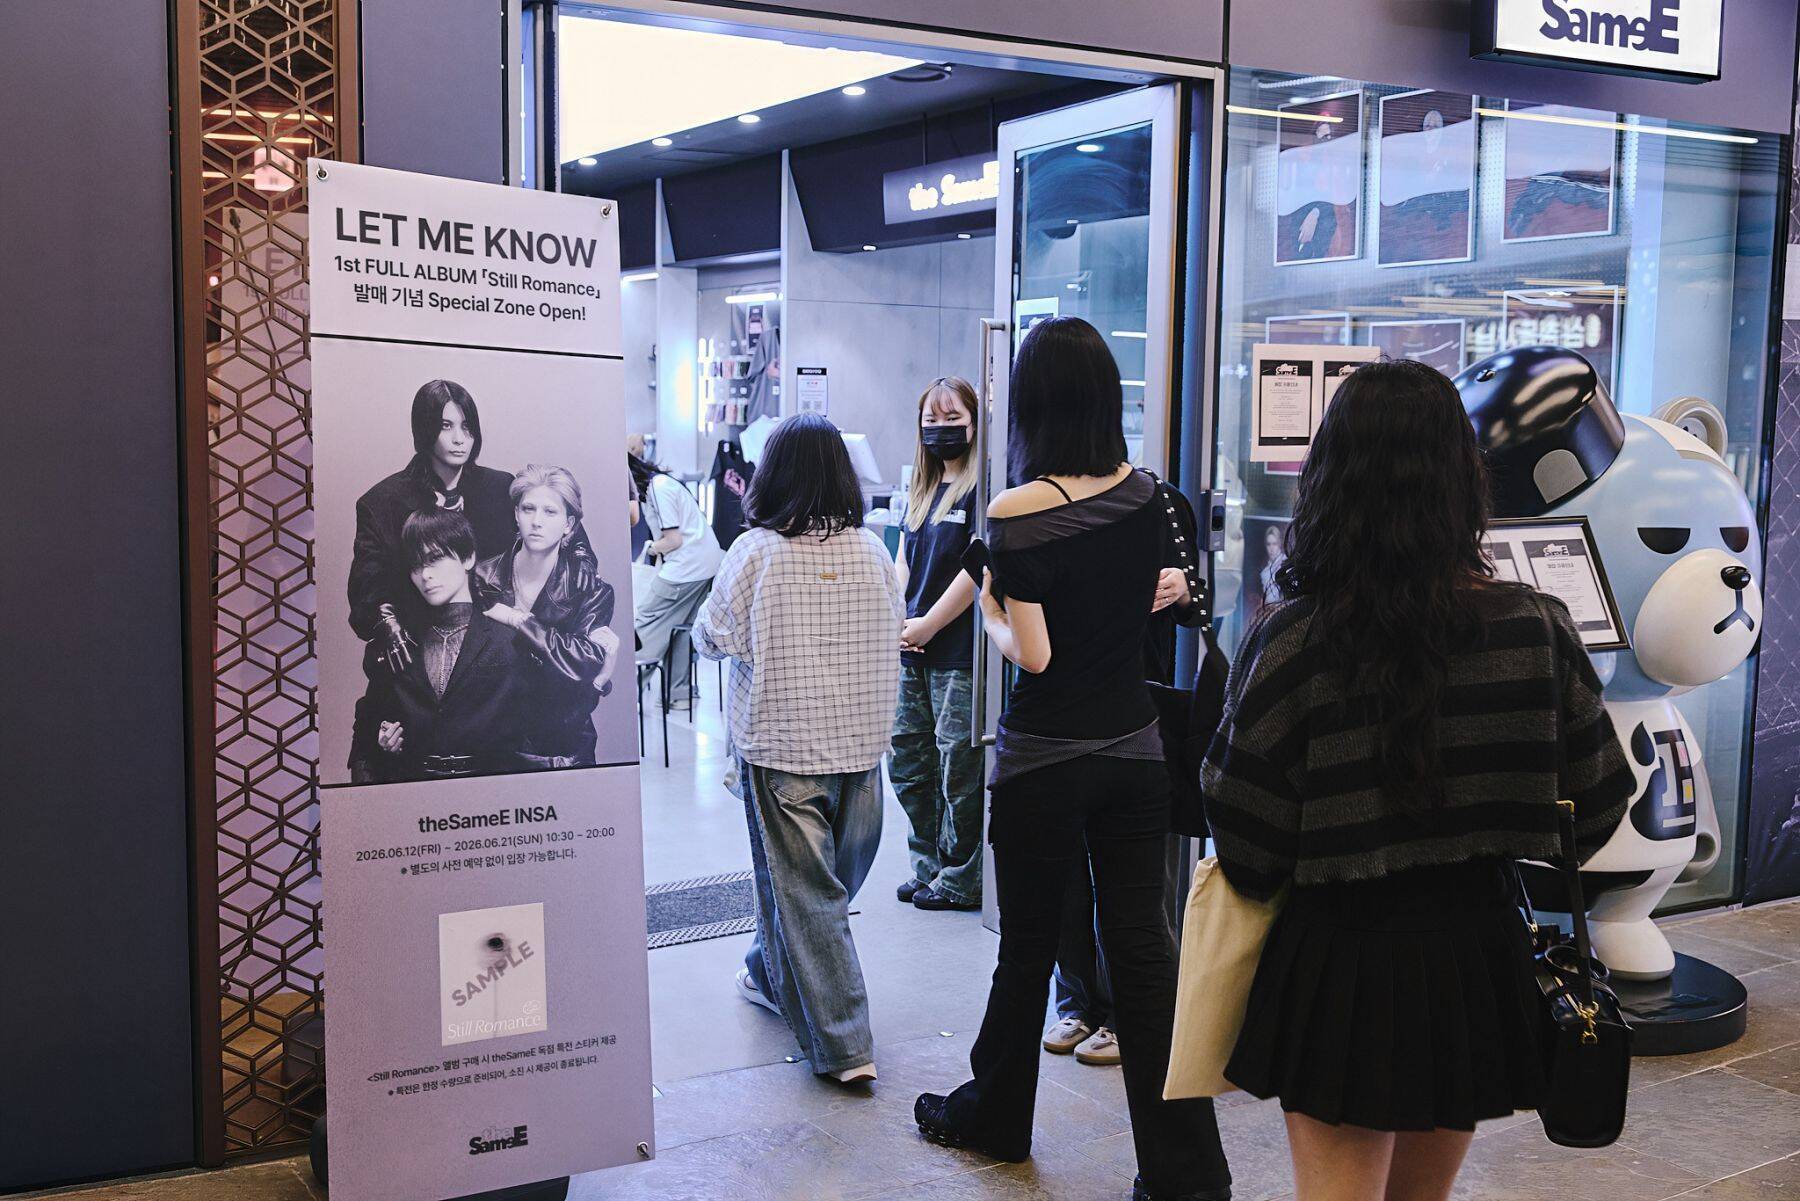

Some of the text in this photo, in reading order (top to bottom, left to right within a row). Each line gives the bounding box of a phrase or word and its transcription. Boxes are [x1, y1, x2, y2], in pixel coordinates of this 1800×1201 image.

[1539, 0, 1680, 54] SameE
[336, 207, 597, 268] LET ME KNOW
[334, 255, 360, 273] 1st
[365, 258, 409, 278] FULL
[414, 264, 477, 285] ALBUM
[354, 284, 586, 322] 발매 기념 Special Zone Open!
[418, 805, 558, 833] theSameE INSA
[356, 843, 441, 862] 2026.06.12(FRI)
[454, 834, 543, 852] 2026.06.21(SUN)
[546, 830, 574, 843] 10:30
[586, 826, 615, 840] 20:00
[410, 848, 577, 876] 별도의 사전 예약 없이 입장 가능합니다.
[451, 941, 535, 1007] SAMPLE
[447, 1014, 541, 1041] Still Romance
[367, 1071, 391, 1082] <Still
[391, 1065, 440, 1080] Romance>
[462, 1056, 480, 1068] 구매
[481, 1054, 490, 1064] 시
[492, 1047, 536, 1062] theSameE
[538, 1044, 556, 1056] 독점
[574, 1038, 600, 1050] 스티커
[600, 1034, 617, 1046] 제공
[422, 1081, 440, 1092] 한정
[440, 1075, 473, 1089] 수량으로
[473, 1070, 508, 1083] 준비되어,
[509, 1067, 526, 1078] 소진
[526, 1065, 535, 1074] 시
[535, 1061, 560, 1073] 제공이
[560, 1055, 598, 1069] 종료됩니다.
[469, 1125, 528, 1155] SameE
